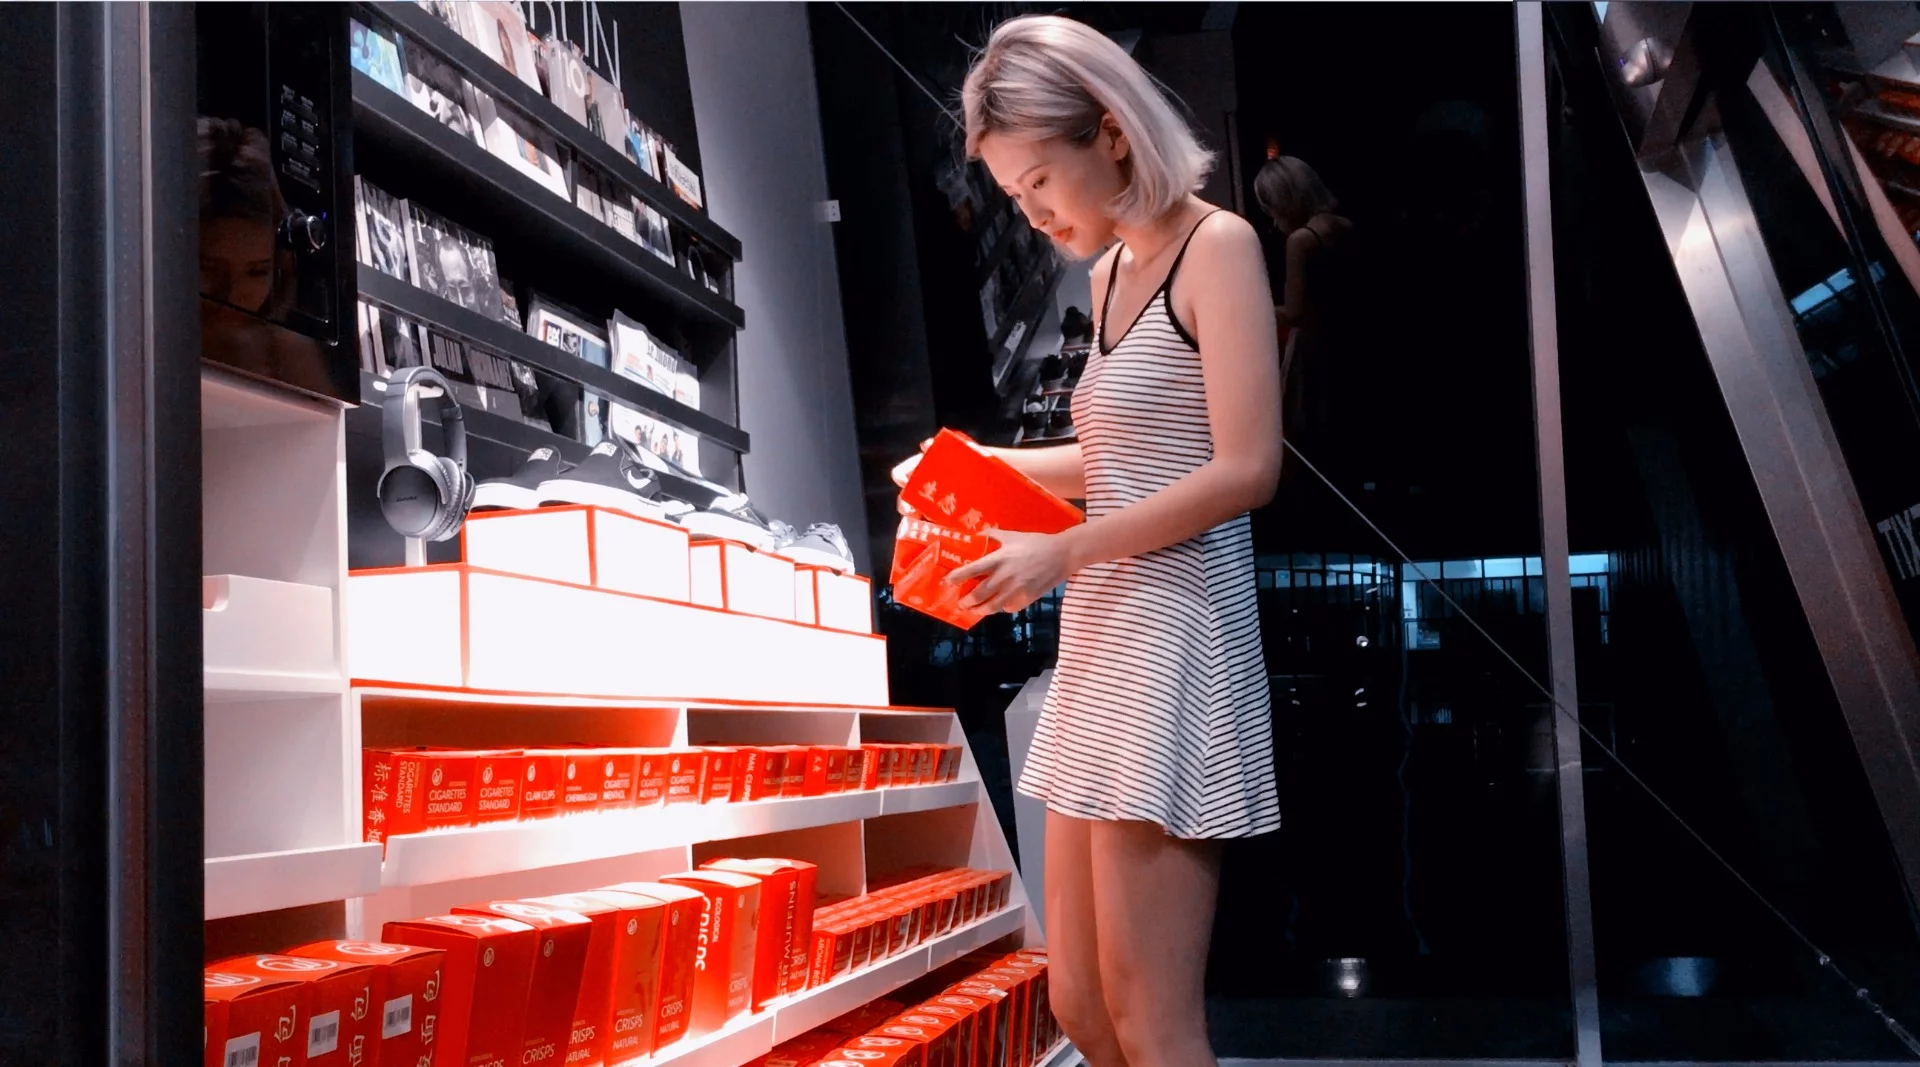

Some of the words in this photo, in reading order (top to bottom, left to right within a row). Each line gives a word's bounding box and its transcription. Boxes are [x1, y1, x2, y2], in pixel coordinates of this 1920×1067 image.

[746, 753, 757, 773] NAIL
[396, 760, 408, 809] STANDARD
[403, 761, 416, 814] CIGARETTES
[480, 786, 515, 799] CIGARETTES
[428, 787, 467, 802] CIGARETTES
[427, 801, 463, 814] STANDARD
[478, 798, 511, 811] STANDARD
[712, 897, 723, 943] ECOLOGICAL
[784, 881, 797, 959] MUFFINS
[815, 937, 825, 968] ARONIA
[661, 1000, 683, 1018] CRISPS
[615, 1014, 643, 1032] CRISPS
[660, 1020, 680, 1034] NATURAL
[569, 1025, 596, 1045] RISPS
[613, 1036, 638, 1050] NATURAL
[523, 1043, 555, 1065] CRISPS
